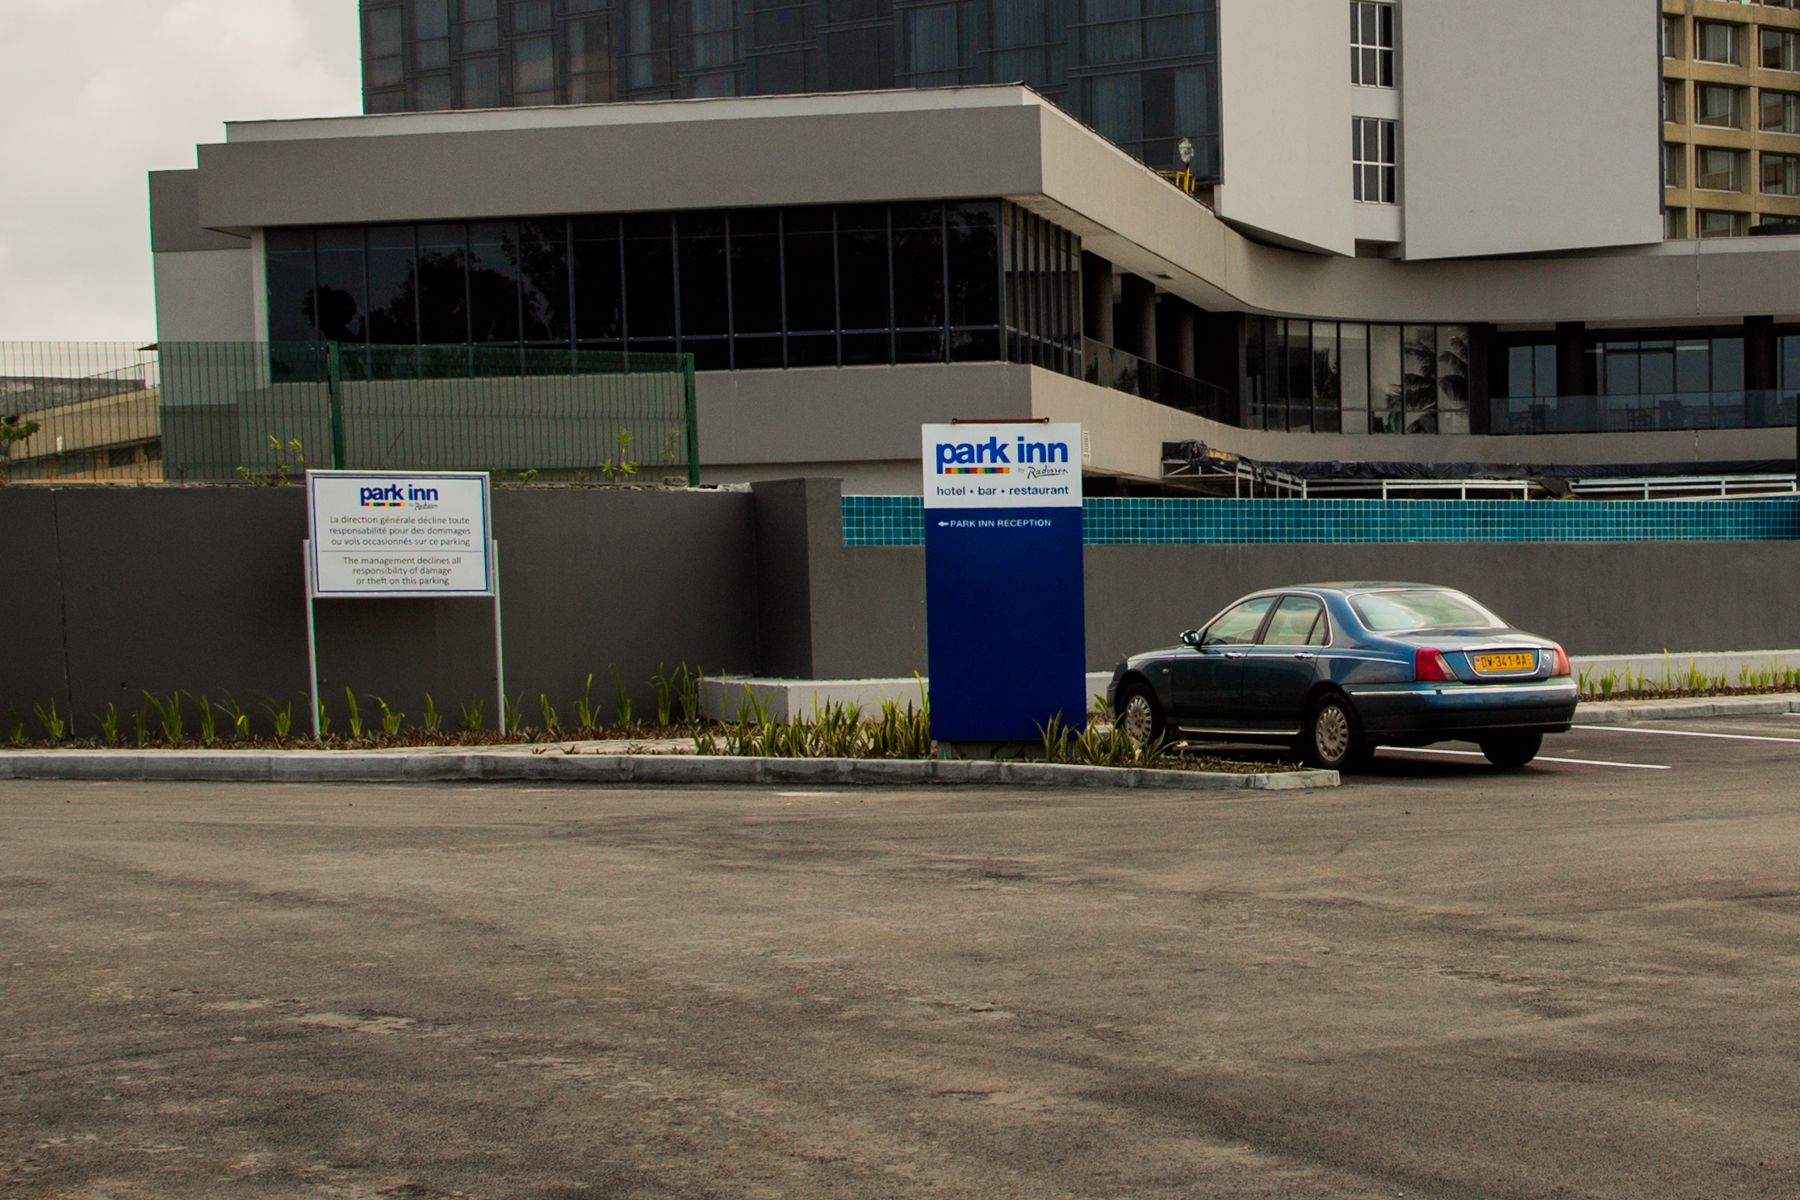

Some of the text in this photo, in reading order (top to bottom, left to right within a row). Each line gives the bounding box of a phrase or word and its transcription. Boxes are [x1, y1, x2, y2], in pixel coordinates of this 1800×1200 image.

[936, 436, 1068, 474] park inn
[1027, 465, 1069, 479] Radisson
[360, 483, 439, 506] park inn
[936, 485, 1069, 496] hotel bar restaurant
[330, 515, 470, 525] La direction générale décline toute
[950, 519, 1051, 528] PARK INN RECEPTION
[329, 527, 471, 537] responsabilité pour des dommages
[344, 538, 361, 546] vols
[362, 538, 413, 546] occasionnés
[440, 538, 471, 548] parking
[343, 556, 462, 566] The management declines all
[352, 566, 452, 576] responsibility of damage
[367, 576, 387, 585] theft
[402, 576, 417, 585] this
[419, 577, 449, 586] parking
